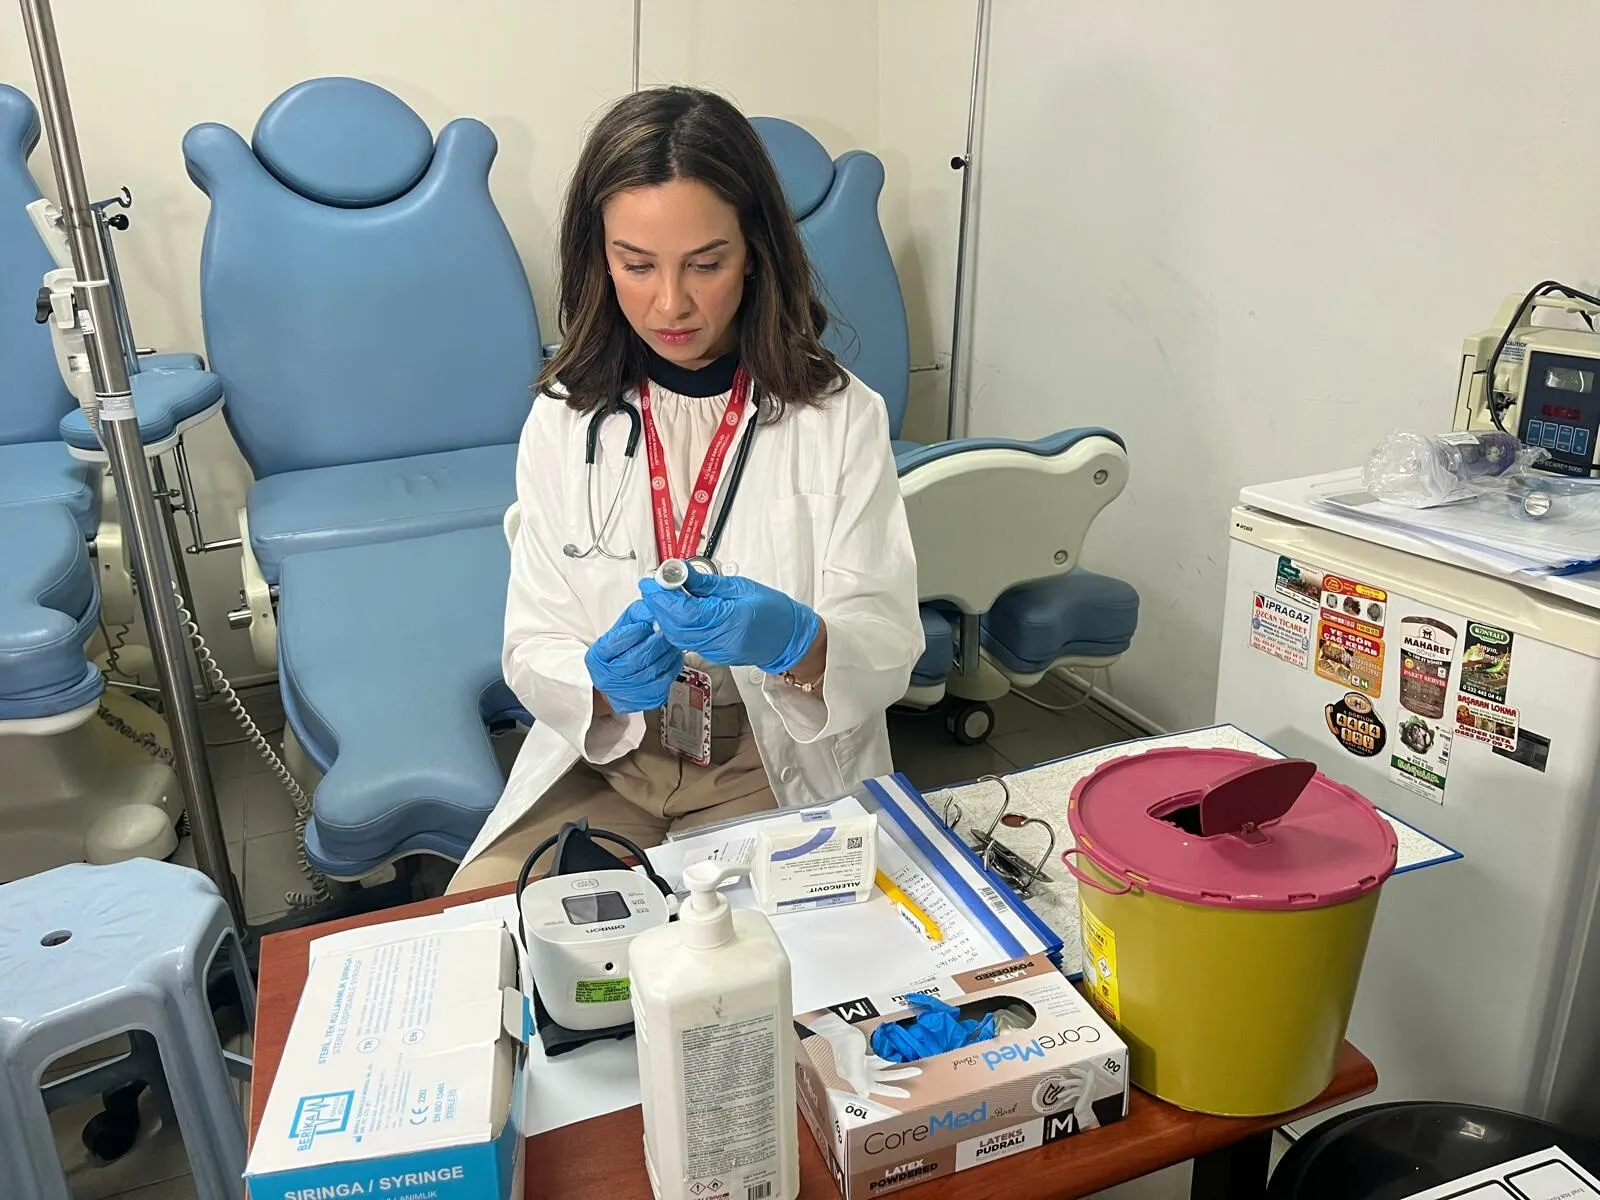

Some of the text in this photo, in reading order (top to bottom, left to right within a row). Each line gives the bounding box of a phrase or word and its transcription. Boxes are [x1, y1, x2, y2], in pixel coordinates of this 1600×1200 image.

[1568, 464, 1583, 473] 5000
[686, 508, 698, 526] HEALTH
[1475, 627, 1504, 640] KONYALI
[1345, 641, 1378, 656] KEBAB
[1404, 637, 1451, 655] MAHARET
[1467, 686, 1477, 694] 232
[1458, 694, 1489, 710] BAŞARAN
[1491, 704, 1517, 717] LOKMA
[1338, 715, 1377, 736] 4 4 4 4
[1489, 733, 1511, 745] USTA
[808, 880, 861, 894] ALLERGOVIT
[974, 961, 1035, 981] POWDERED
[992, 969, 1027, 985] LATEX
[338, 985, 357, 1025] DISPOSABLE
[838, 1001, 867, 1022] M
[324, 1023, 335, 1038] TEK
[331, 1023, 347, 1054] STERILE
[982, 1025, 1101, 1071] CoreMed
[1104, 1057, 1121, 1073] 100
[845, 1105, 868, 1120] 100
[297, 1113, 316, 1152] BERİKA
[864, 1101, 988, 1155] CoreMed
[1051, 1113, 1073, 1138] M
[975, 1135, 1025, 1157] PUDRALI
[979, 1128, 1023, 1148] LATEKS
[379, 1165, 465, 1191] SYRINGE
[869, 1162, 938, 1190] POWDERED
[884, 1158, 925, 1178] LATEX
